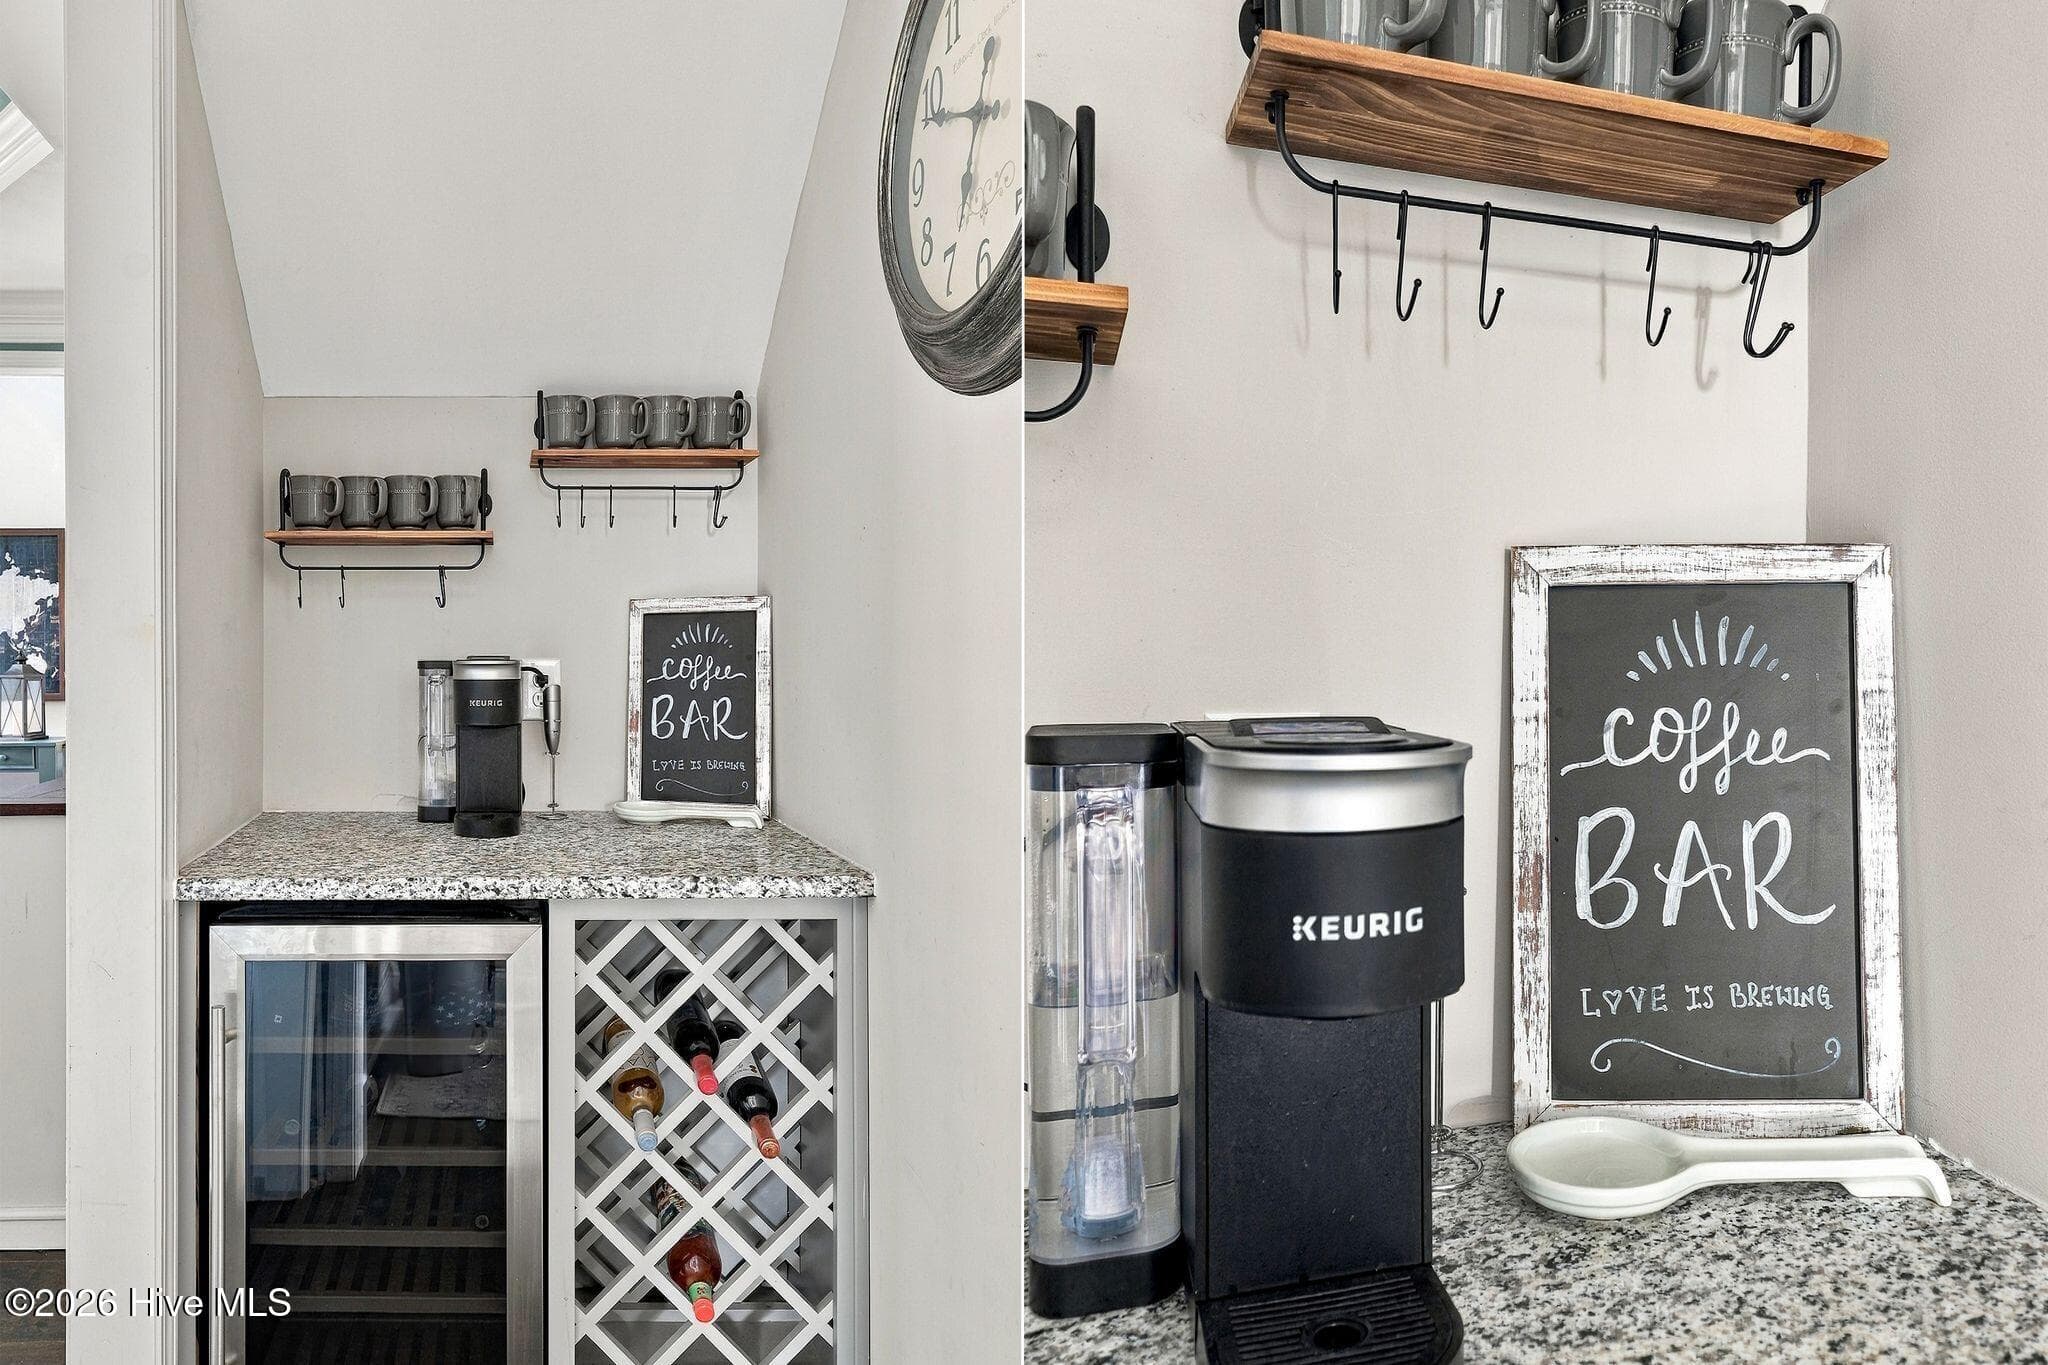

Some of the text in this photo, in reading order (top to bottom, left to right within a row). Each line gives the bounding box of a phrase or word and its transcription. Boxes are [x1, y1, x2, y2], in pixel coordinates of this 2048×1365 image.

[945, 0, 961, 55] 11
[922, 65, 944, 130] 10
[912, 158, 925, 208] 9
[920, 216, 934, 267] 8
[975, 238, 991, 290] 6
[943, 241, 957, 298] 7
[469, 699, 503, 707] KEURIG
[651, 694, 748, 741] BAR
[690, 760, 702, 771] IS
[706, 759, 746, 772] BREWING
[1575, 806, 1836, 931] BAR
[1292, 906, 1424, 942] KEURIG
[1685, 984, 1715, 1012] IS
[1729, 981, 1834, 1010] BREWING
